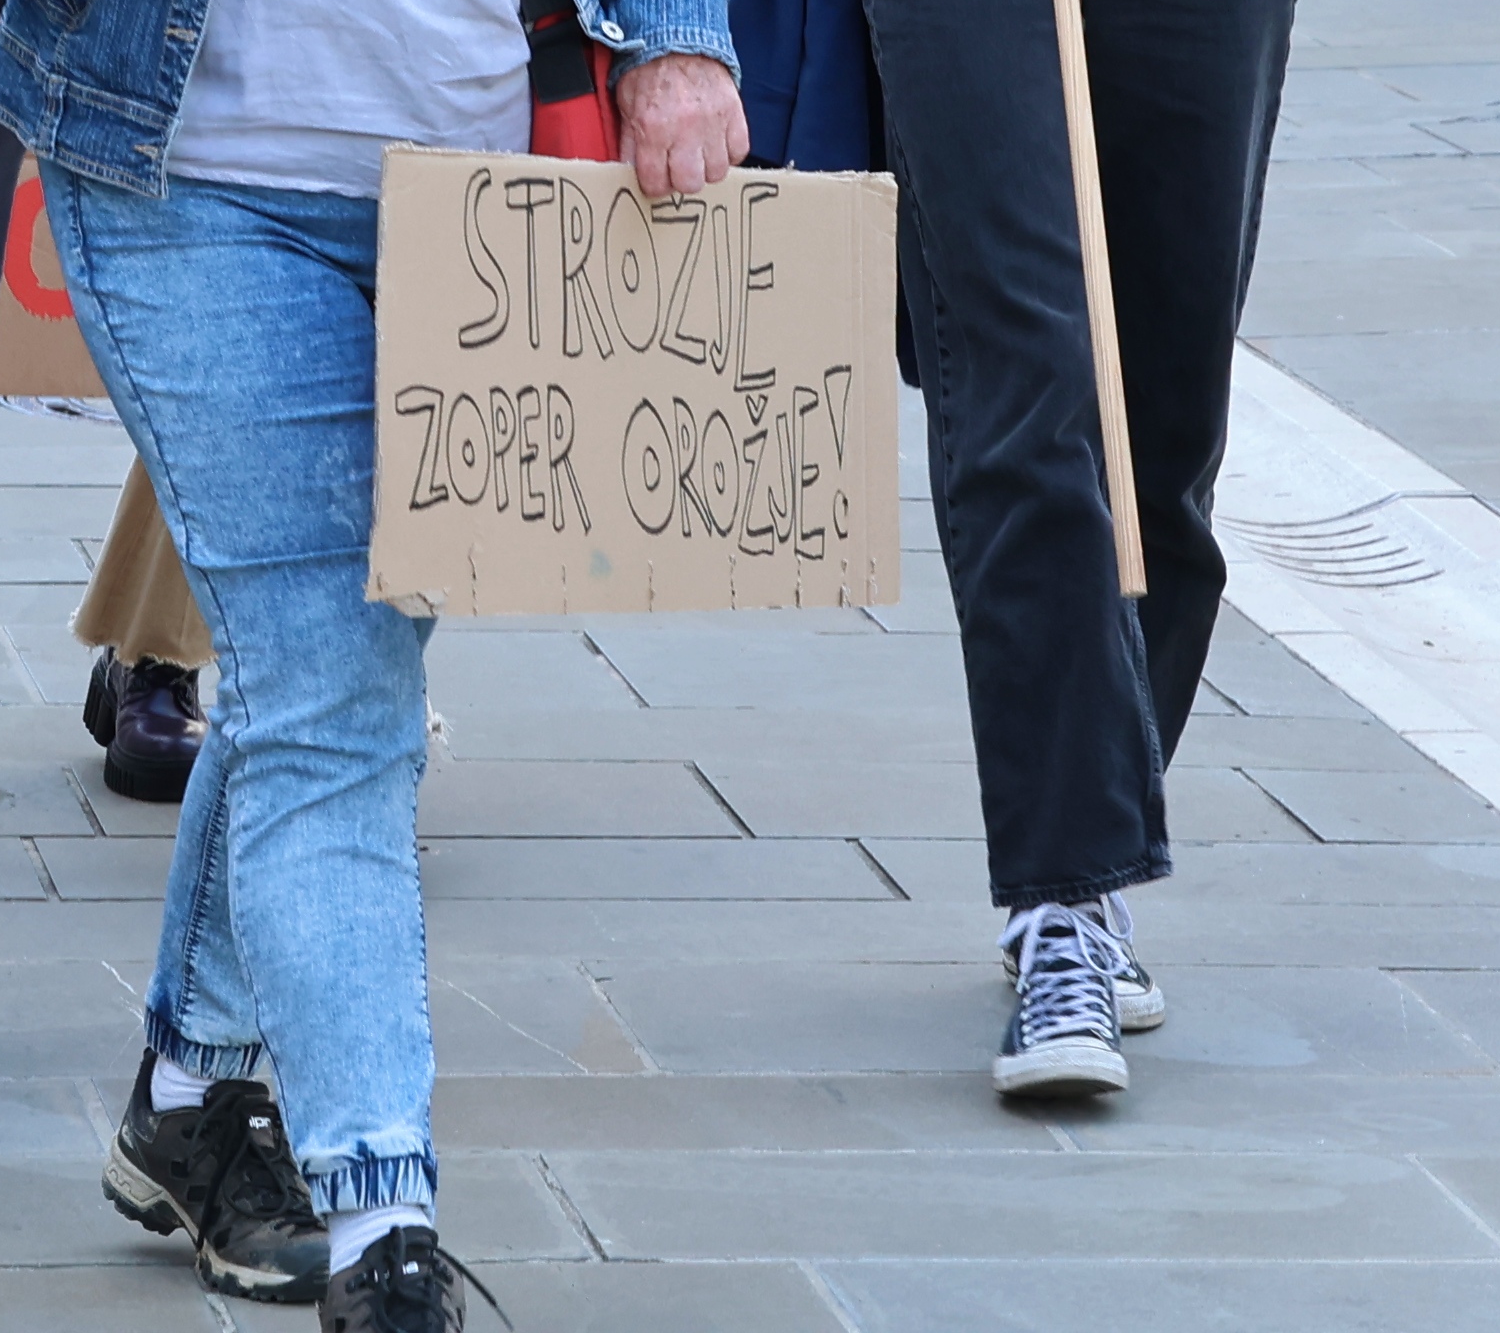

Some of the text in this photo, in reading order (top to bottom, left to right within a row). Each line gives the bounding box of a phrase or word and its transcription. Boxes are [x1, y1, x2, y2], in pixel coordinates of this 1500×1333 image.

[458, 168, 779, 392] STROŽJE
[395, 366, 852, 560] ZOPER OROŽJE!
